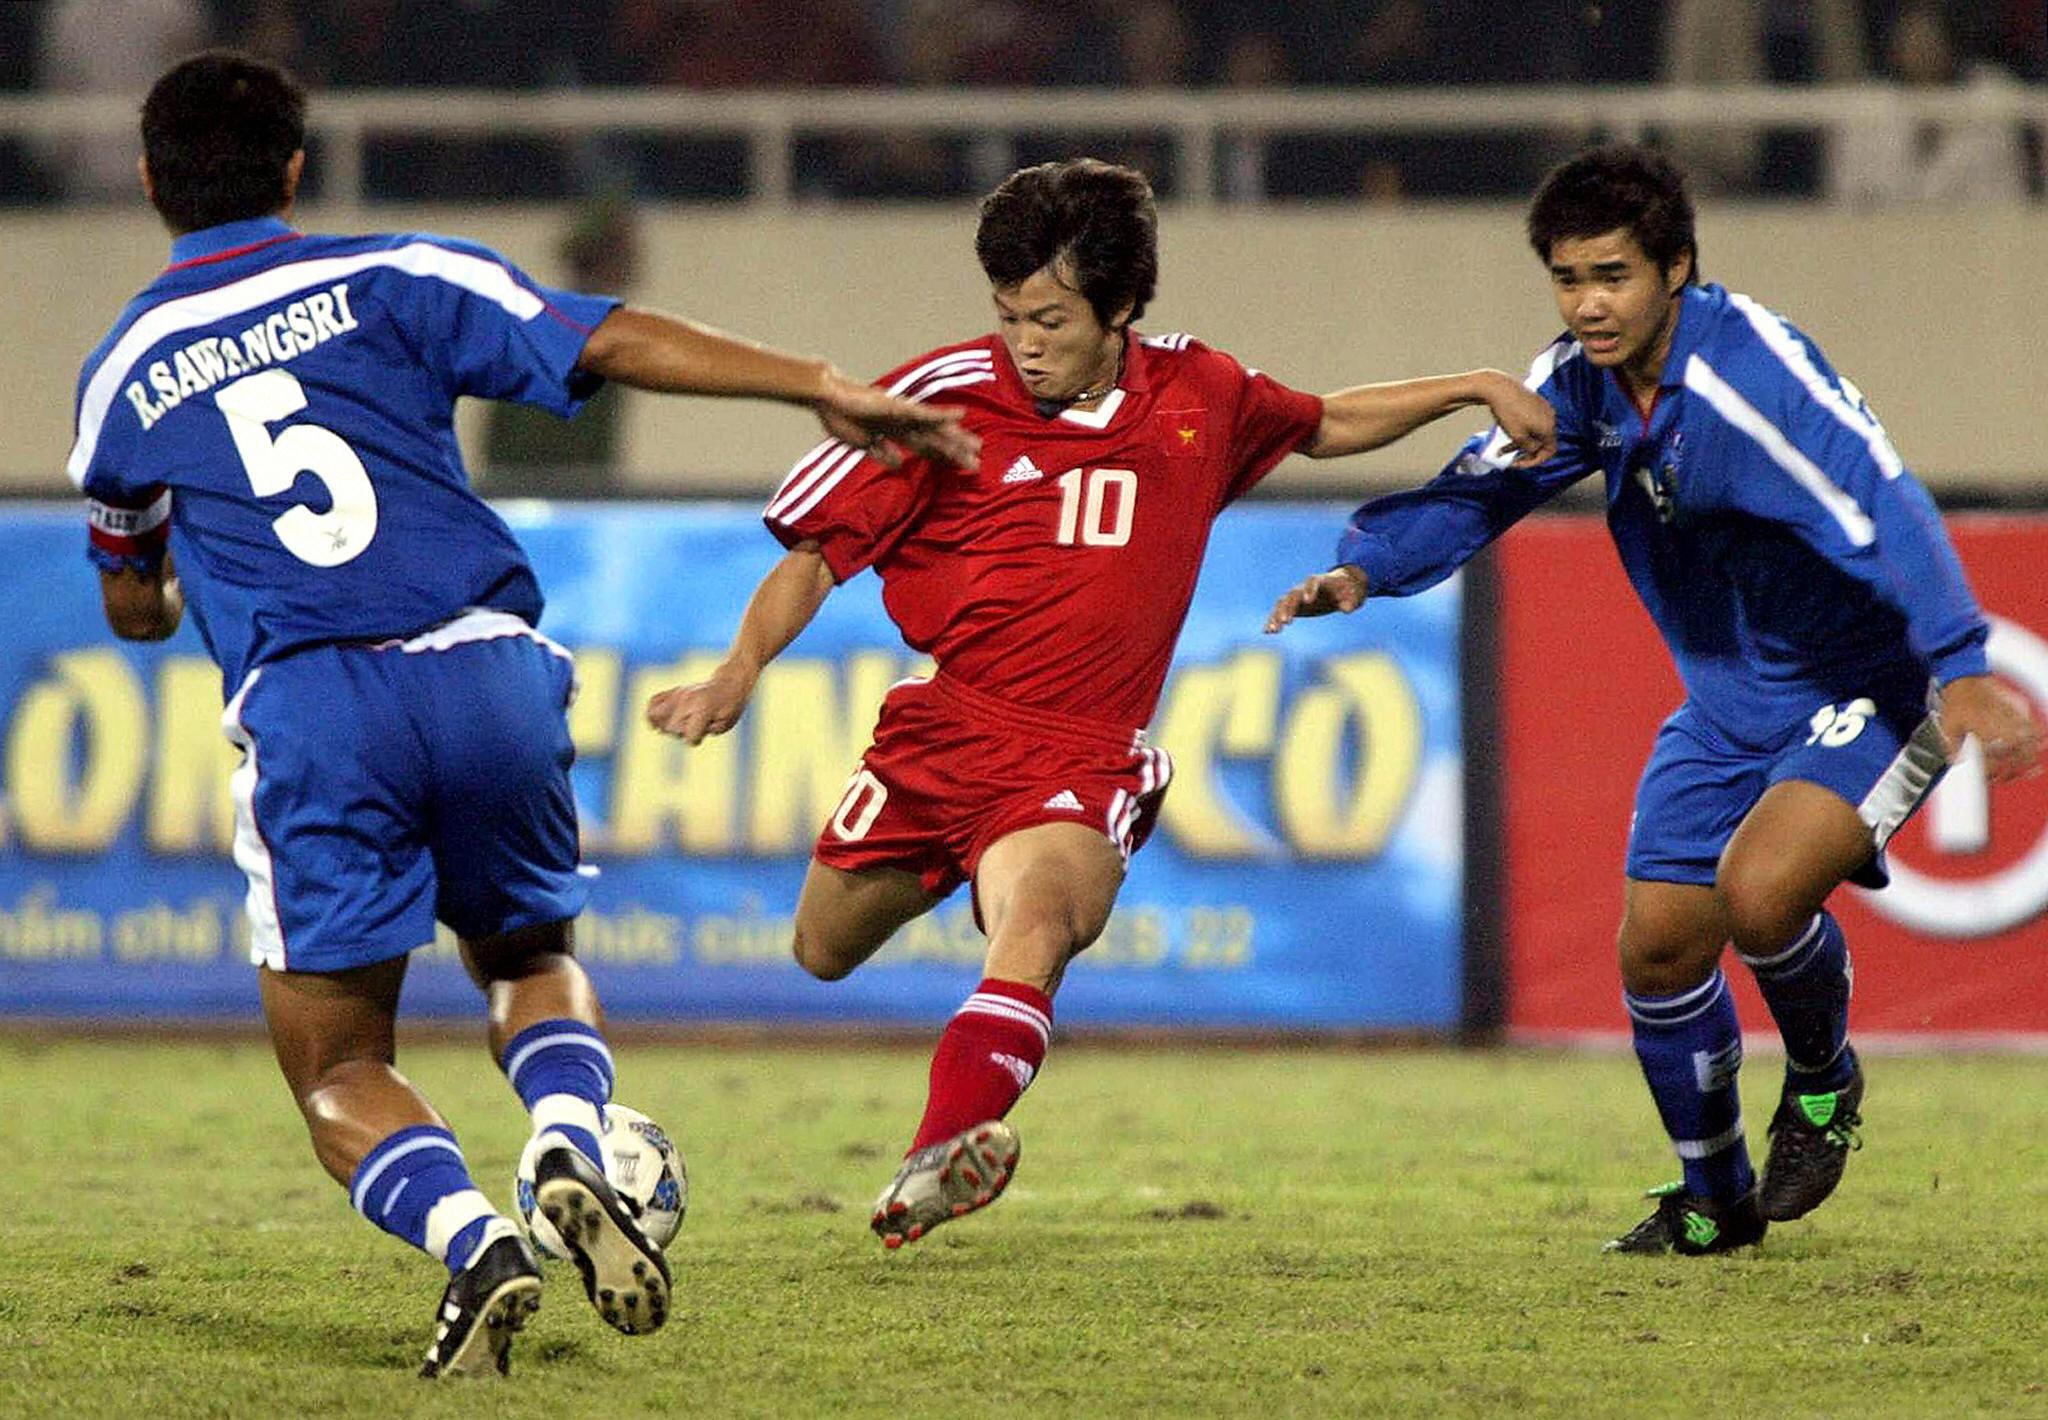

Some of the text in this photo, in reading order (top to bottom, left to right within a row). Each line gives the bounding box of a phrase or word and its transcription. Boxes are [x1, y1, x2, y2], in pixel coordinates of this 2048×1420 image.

[125, 283, 359, 431] R.SAWANGSRI
[214, 367, 378, 568] 5
[1057, 467, 1139, 547] 10
